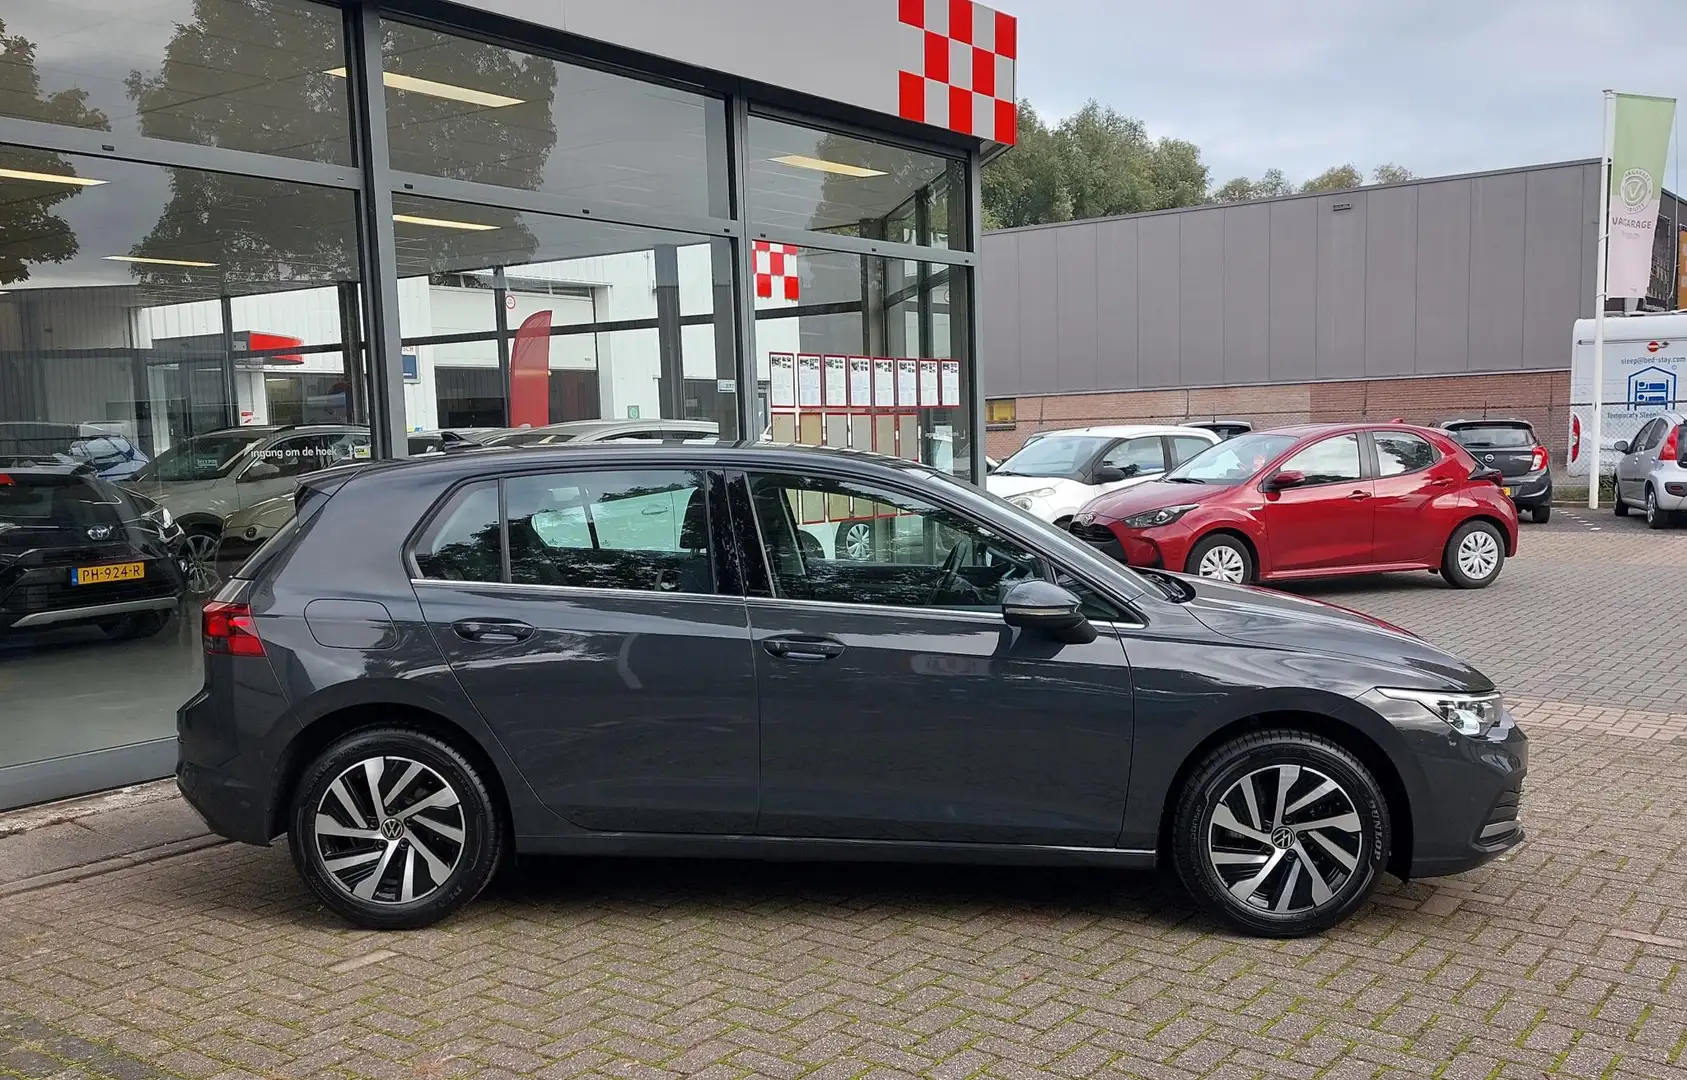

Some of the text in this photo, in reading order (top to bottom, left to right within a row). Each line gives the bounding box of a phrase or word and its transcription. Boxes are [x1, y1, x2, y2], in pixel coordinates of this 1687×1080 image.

[1620, 356, 1686, 365] sleep@bed-stay.com
[1607, 412, 1638, 421] Temporary
[250, 445, 338, 460] ingang om de hoek
[82, 564, 141, 582] PH-924-R
